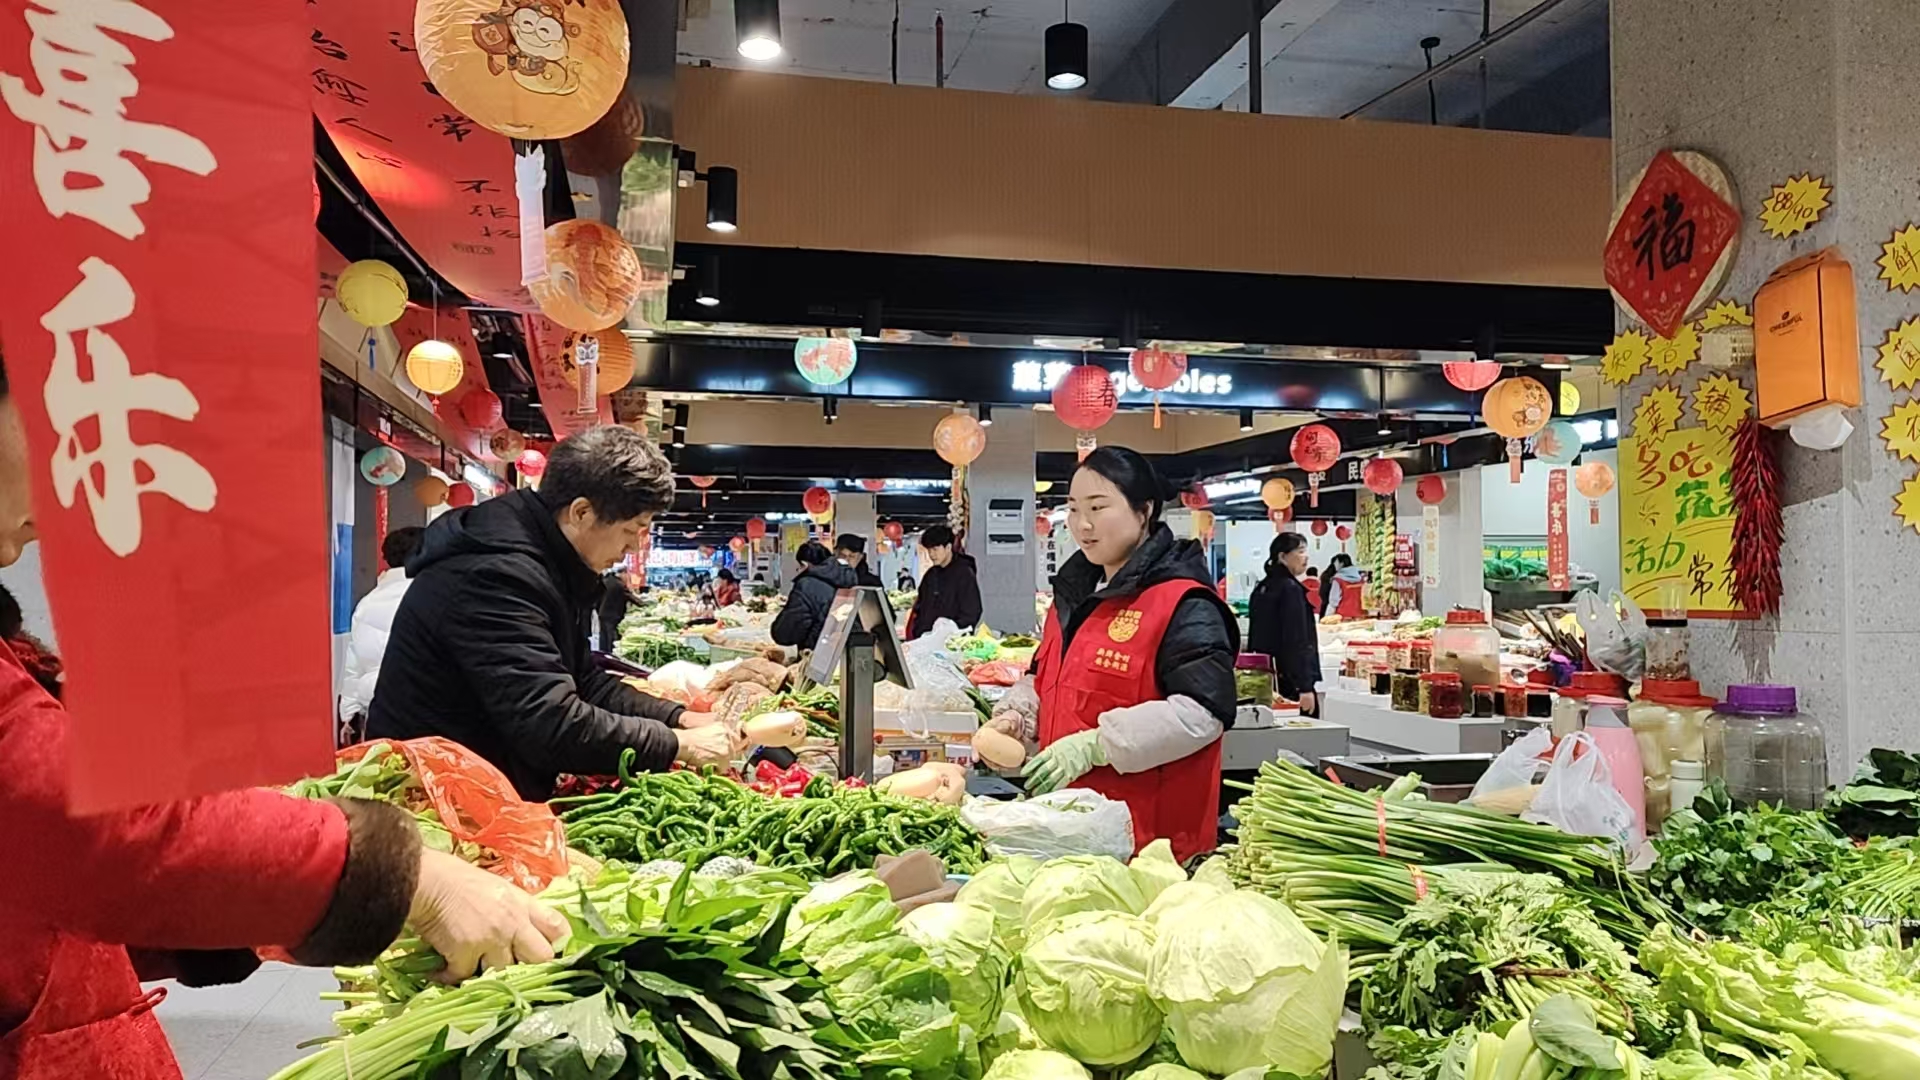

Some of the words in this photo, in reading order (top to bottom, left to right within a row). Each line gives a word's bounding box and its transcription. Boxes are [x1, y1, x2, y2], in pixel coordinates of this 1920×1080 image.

[1772, 189, 1813, 225] 88/90
[1632, 191, 1697, 281] 福
[1098, 378, 1118, 409] 春
[1641, 400, 1669, 436] 菜
[1625, 531, 1686, 574] 活力
